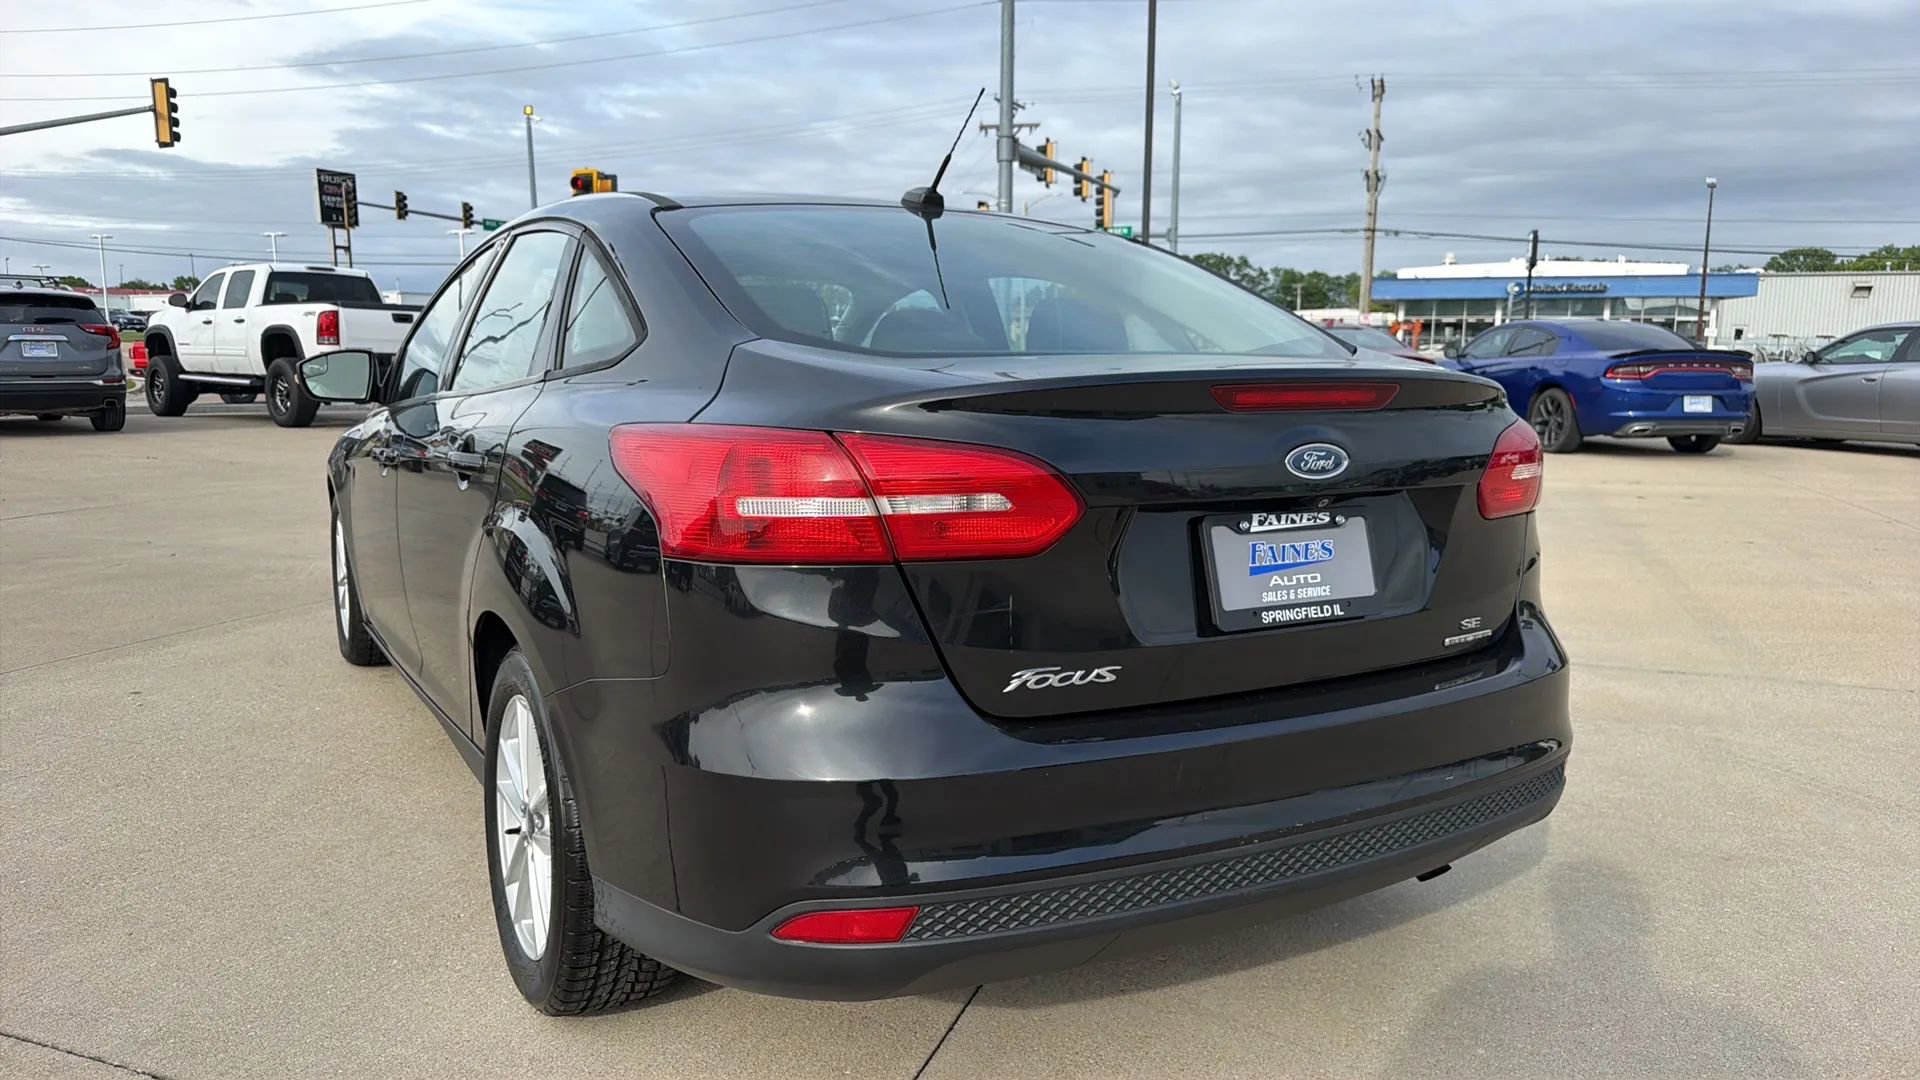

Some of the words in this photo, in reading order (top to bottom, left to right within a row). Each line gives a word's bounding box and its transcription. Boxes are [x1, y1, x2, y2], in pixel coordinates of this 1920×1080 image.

[1301, 451, 1335, 471] Ford
[1250, 512, 1331, 527] FAINE'S
[1249, 540, 1335, 566] FAINE'S
[1269, 573, 1321, 587] AUTO
[1262, 591, 1288, 602] SALES
[1290, 590, 1295, 600] &
[1297, 586, 1331, 599] SERVICE
[1261, 606, 1332, 624] SPRINGFIELD
[1333, 604, 1345, 616] IL
[1461, 617, 1481, 629] SE
